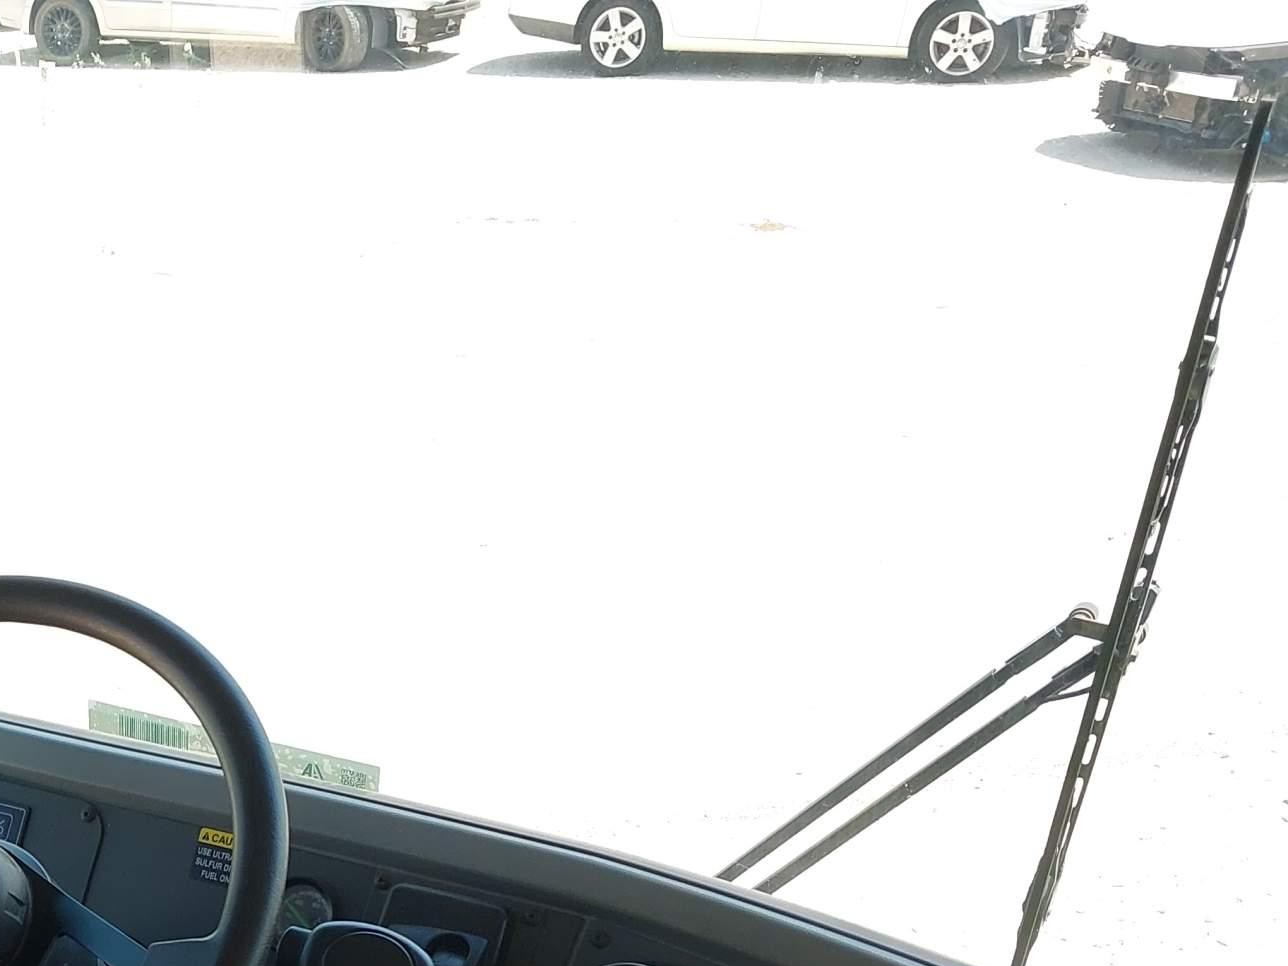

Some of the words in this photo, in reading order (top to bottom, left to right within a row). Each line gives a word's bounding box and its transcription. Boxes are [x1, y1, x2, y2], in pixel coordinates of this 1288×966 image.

[197, 847, 212, 856] USE
[195, 857, 223, 870] SULFUR
[200, 870, 218, 881] FUEL
